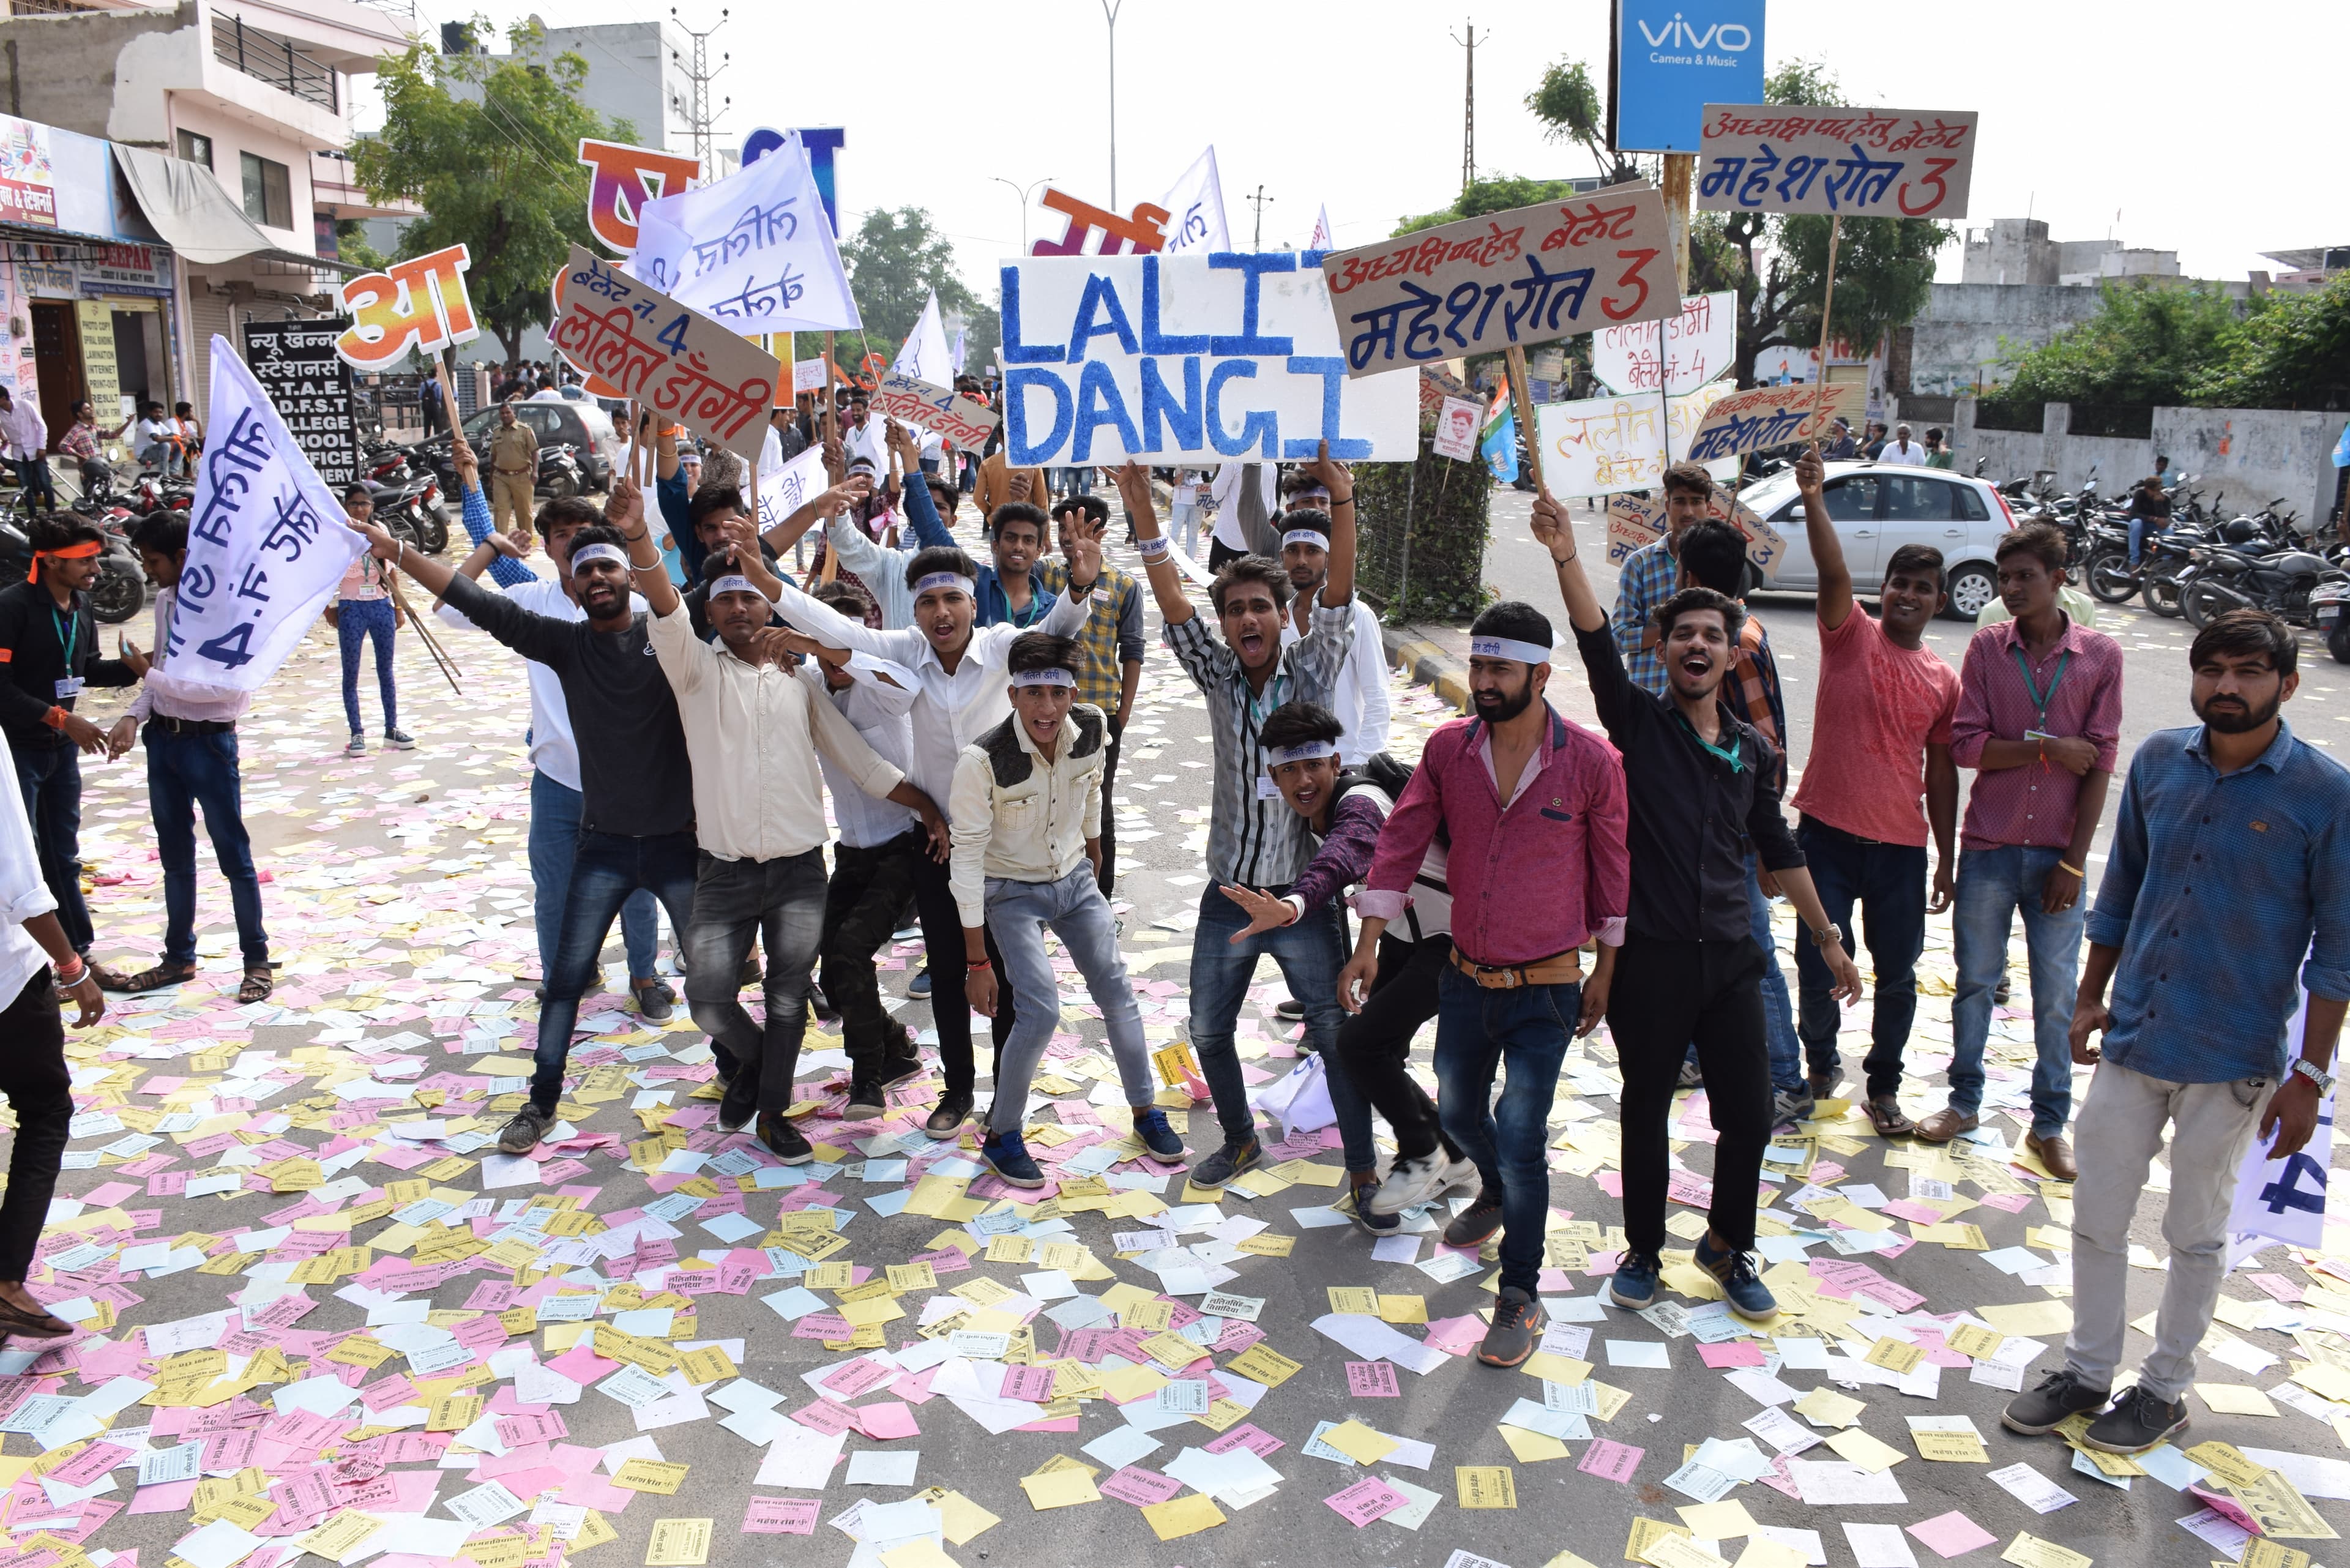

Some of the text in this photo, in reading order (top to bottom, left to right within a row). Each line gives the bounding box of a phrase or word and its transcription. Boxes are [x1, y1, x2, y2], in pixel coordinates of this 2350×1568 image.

[1639, 12, 1751, 51] vivo
[1649, 52, 1737, 68] Camera & Music
[1889, 119, 1969, 152] बेलेट
[15, 189, 23, 209] &
[1898, 157, 1958, 216] 3
[1541, 204, 1638, 252] बेलेट
[98, 246, 152, 271] DEEPAK
[1600, 248, 1660, 321] 3
[1001, 250, 1340, 365] LALI
[248, 333, 284, 356] न्यू
[657, 313, 691, 357] 4
[86, 351, 114, 359] LAMINATION
[557, 302, 668, 396] ललित
[87, 365, 115, 374] INTERNET
[255, 353, 340, 378] स्टेशनर्स
[89, 380, 117, 389] PRINT-OUT
[91, 394, 119, 403] RESULT
[870, 392, 940, 422] ललित
[934, 395, 955, 412] 4
[1004, 356, 1373, 466] DANGI
[294, 434, 352, 448] HOOL
[1652, 512, 1669, 534] 4
[1209, 1297, 1244, 1307] ललितसिंह
